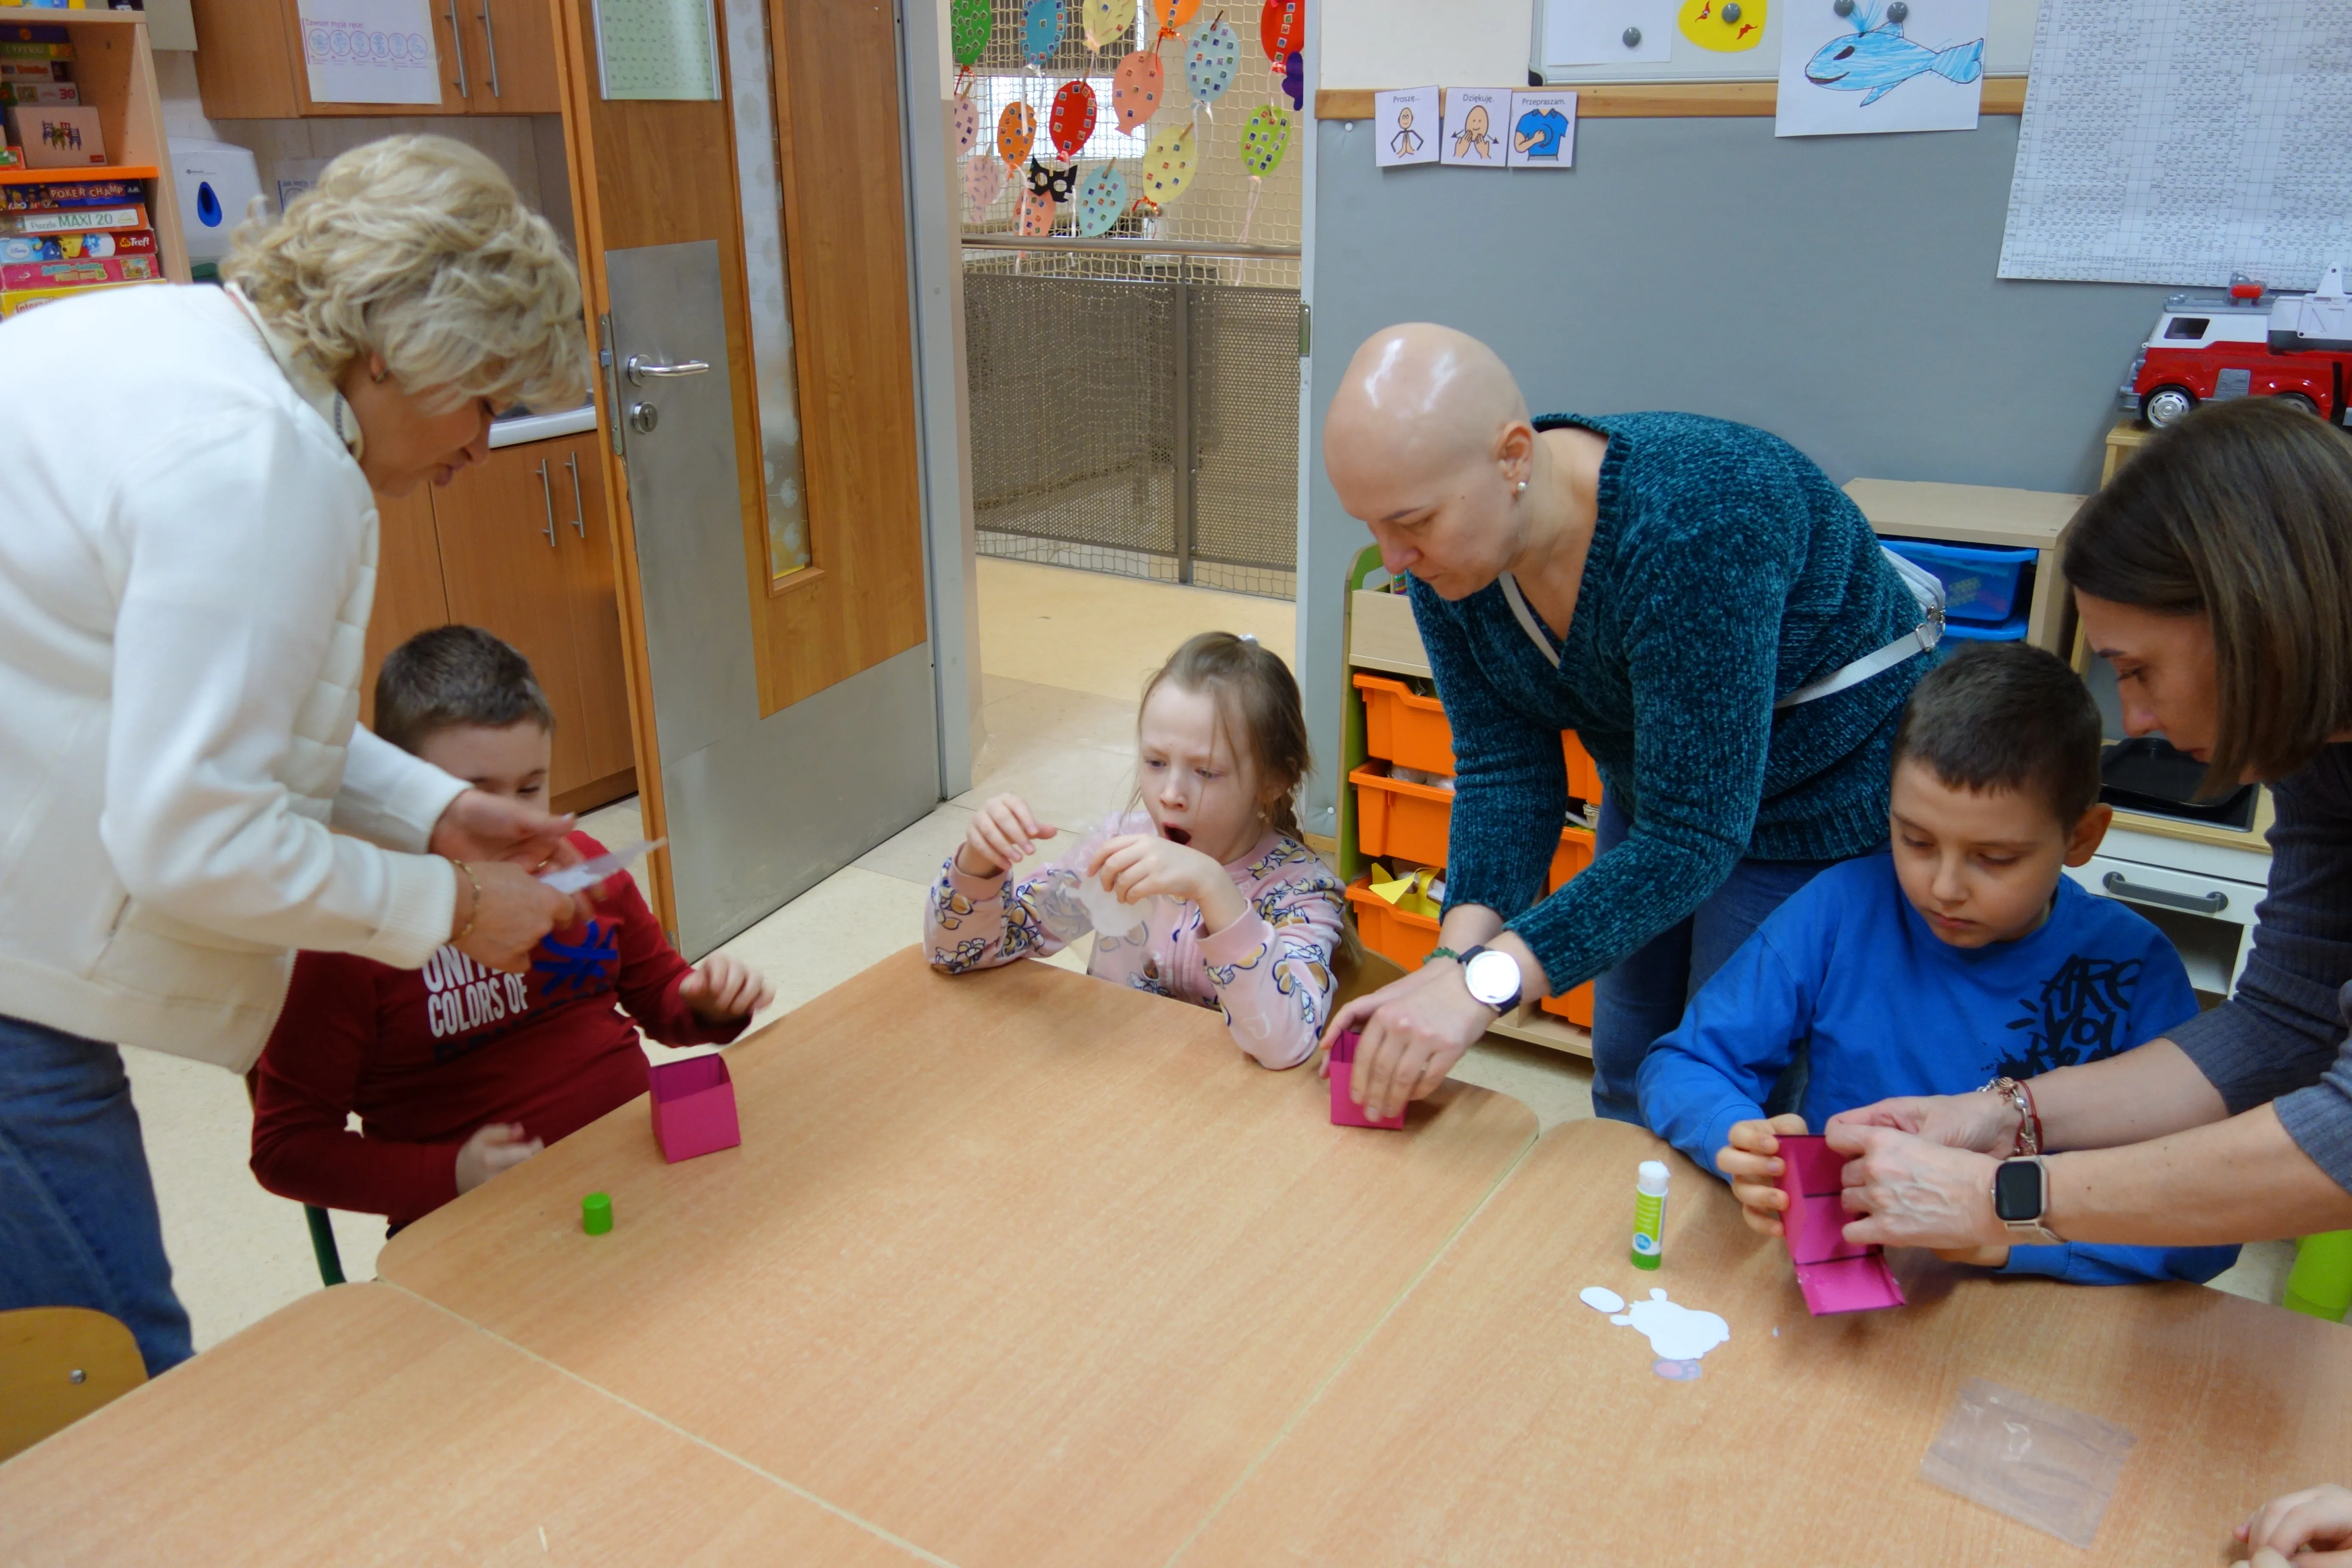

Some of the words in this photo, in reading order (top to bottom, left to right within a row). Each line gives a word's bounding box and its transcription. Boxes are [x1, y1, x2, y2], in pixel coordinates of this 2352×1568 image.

[59, 89, 75, 99] 30
[50, 187, 86, 199] POKER
[89, 185, 123, 198] CHAMP
[58, 214, 92, 227] MAXI
[96, 214, 113, 225] 20
[130, 237, 150, 247] Trefl
[428, 977, 505, 1038] COLORS
[503, 972, 529, 1014] OF
